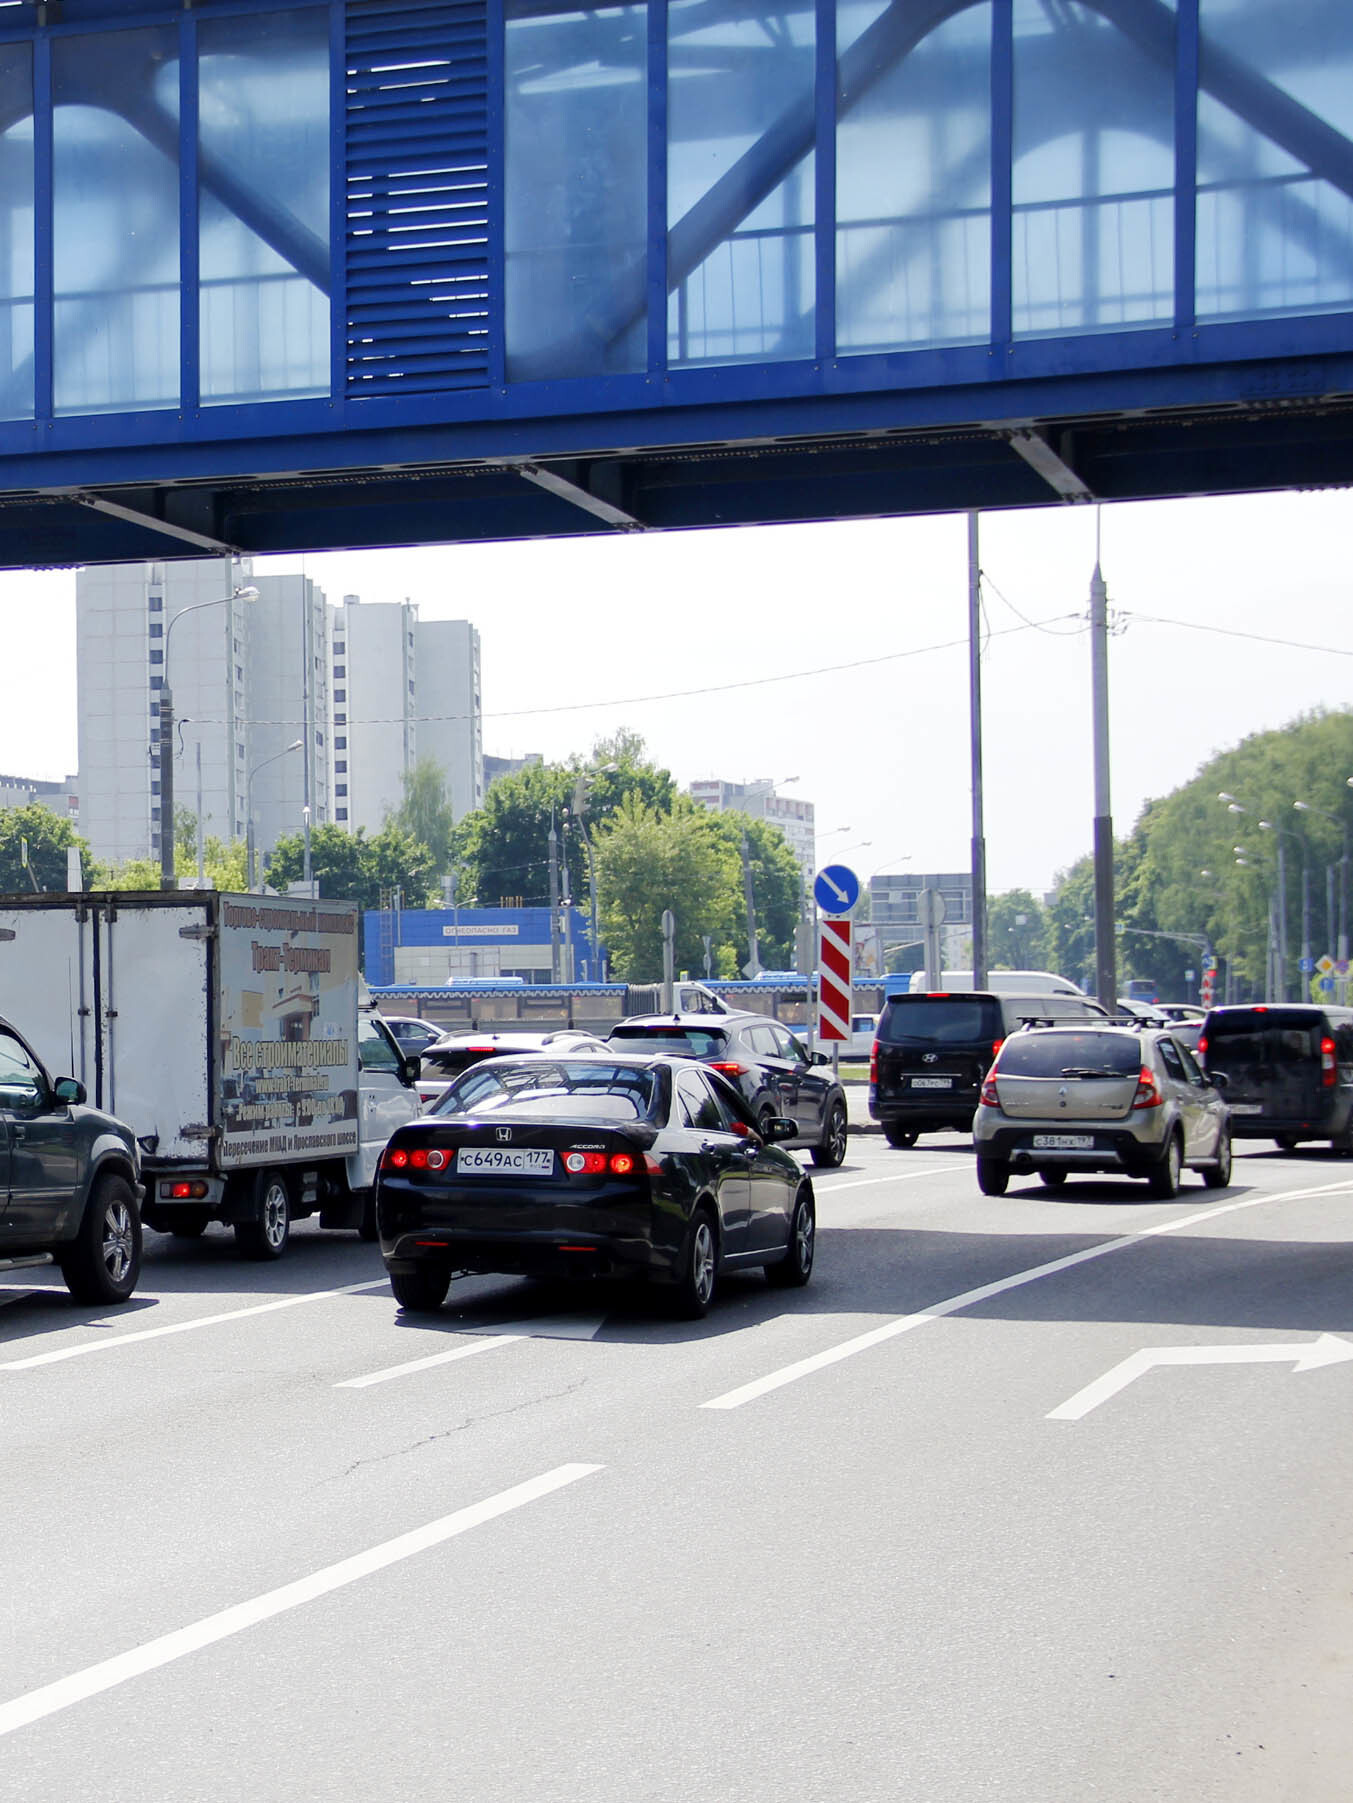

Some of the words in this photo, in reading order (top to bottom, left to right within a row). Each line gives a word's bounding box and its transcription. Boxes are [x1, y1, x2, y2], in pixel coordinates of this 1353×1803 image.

[233, 1036, 253, 1070] Все
[255, 1038, 348, 1071] стройматериалы
[223, 1140, 268, 1158] Пересечение
[288, 1137, 293, 1151] и
[526, 1151, 548, 1163] 177
